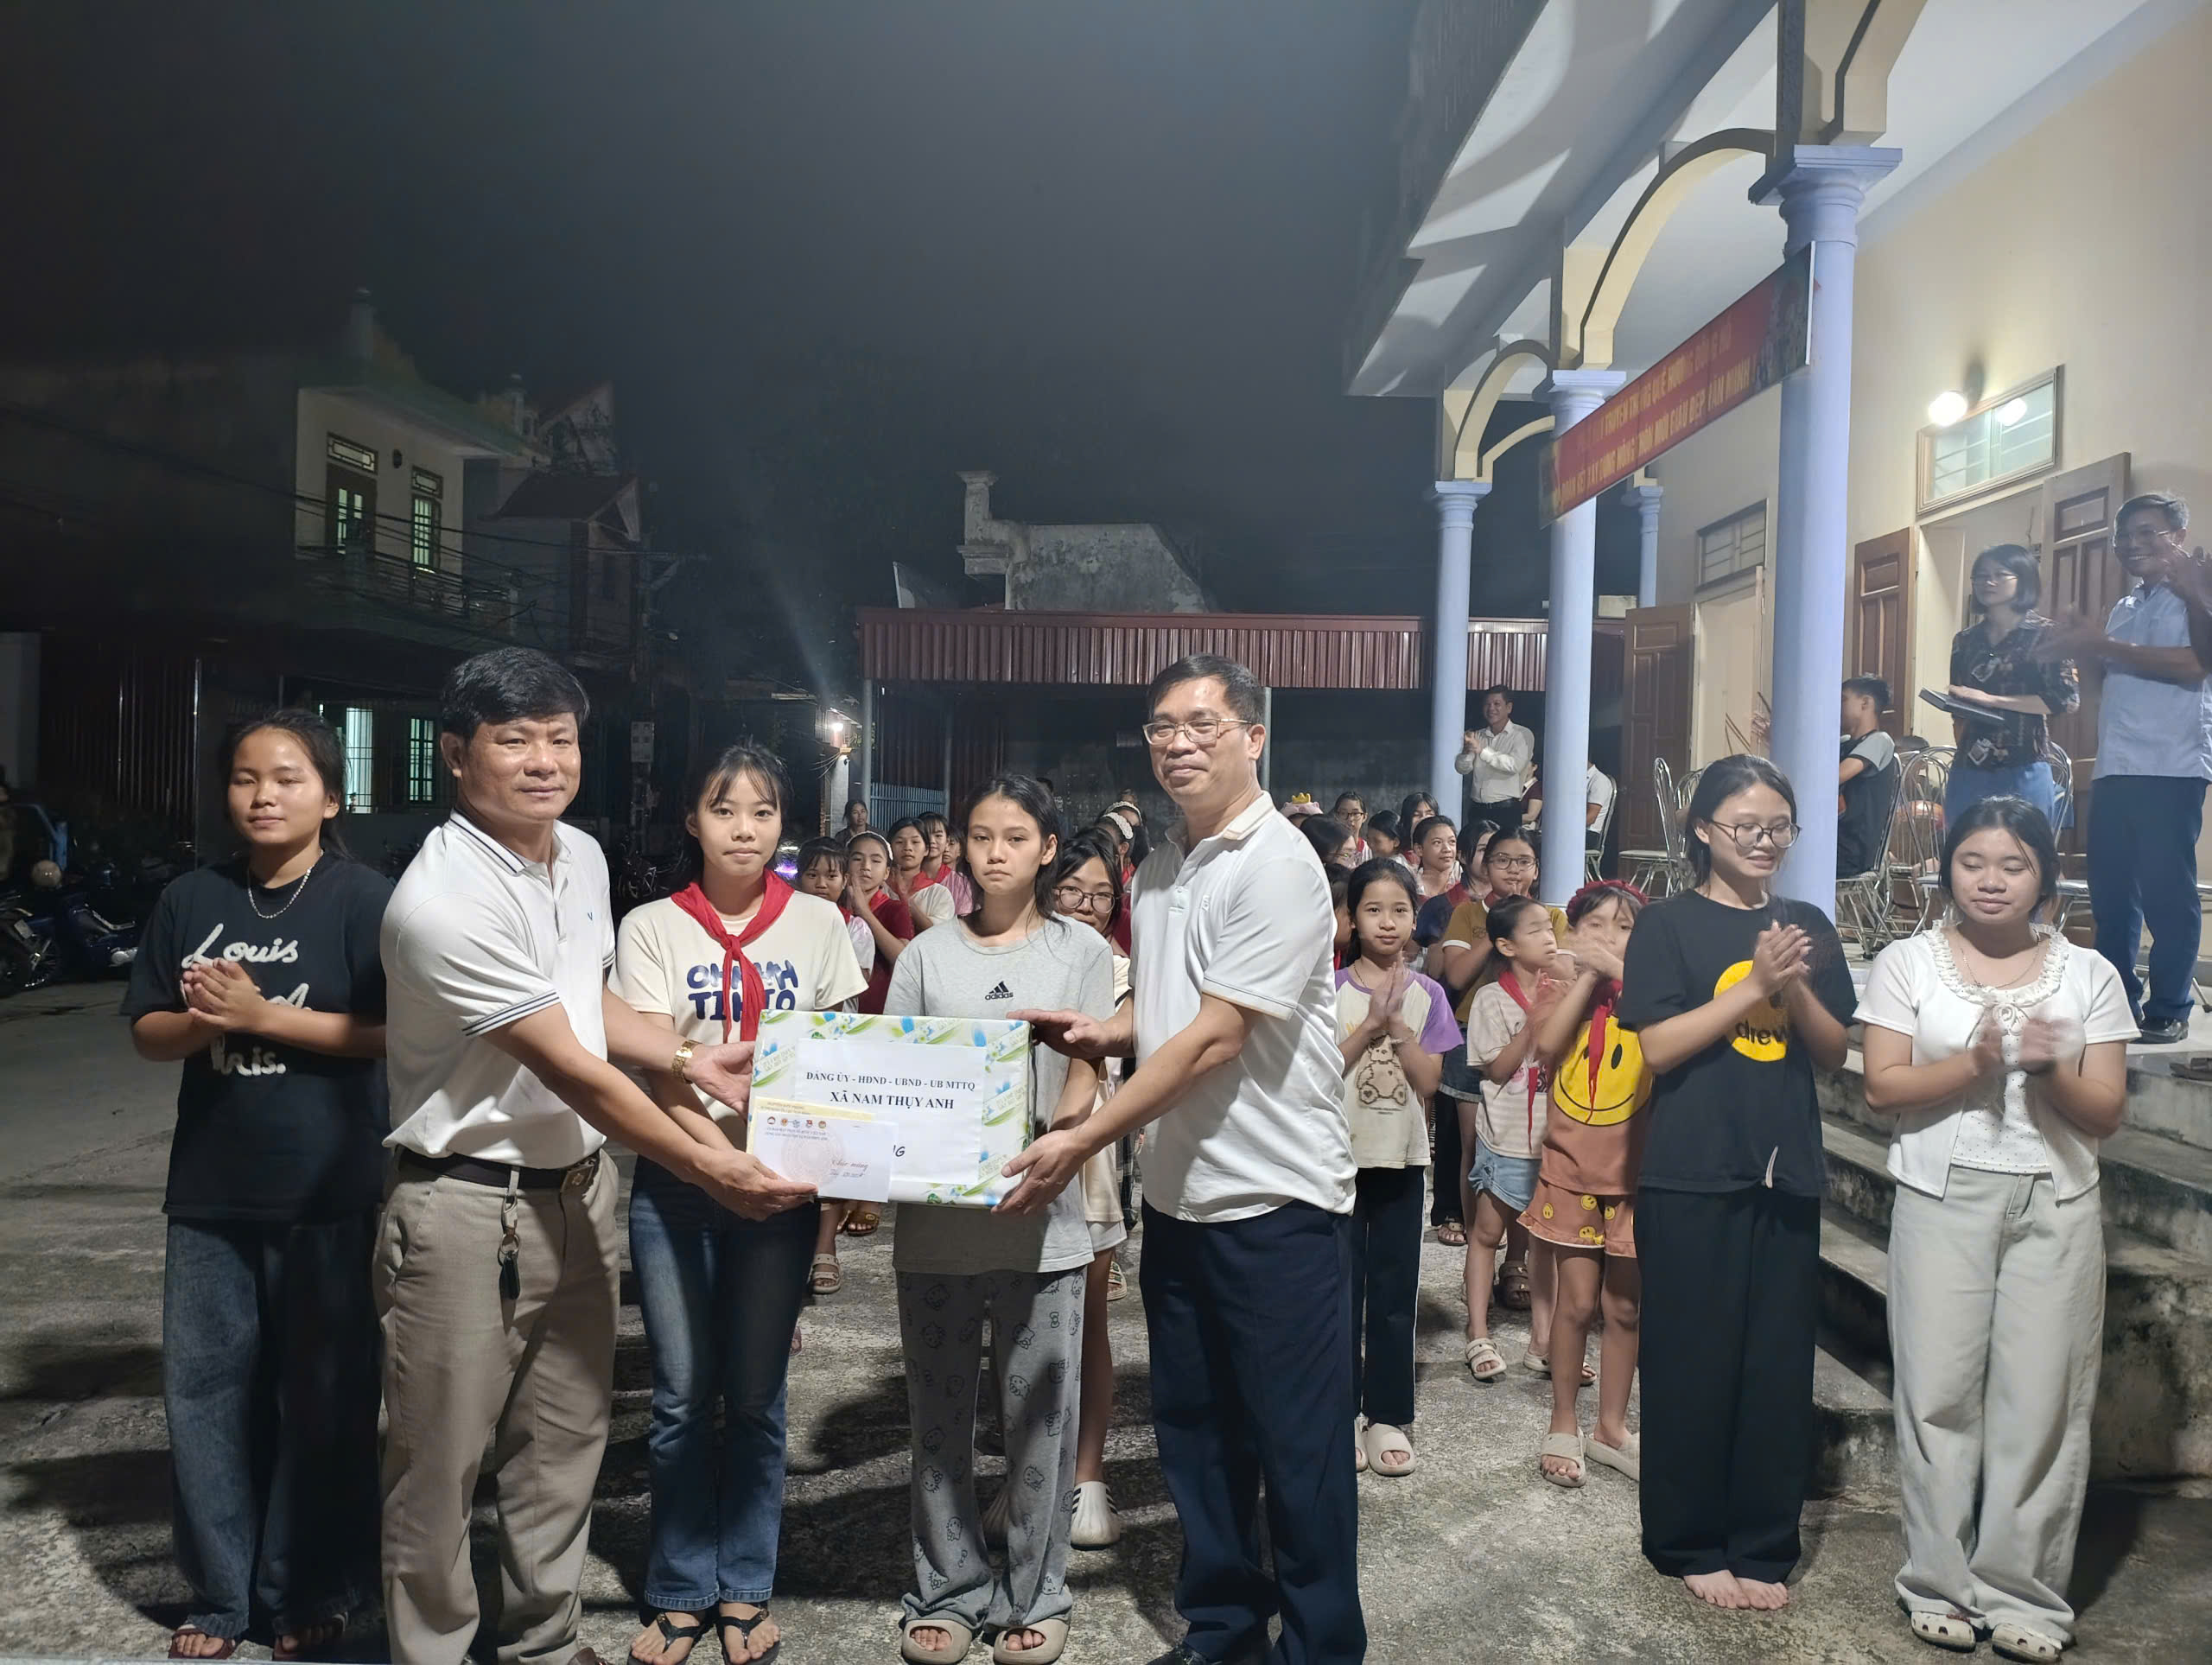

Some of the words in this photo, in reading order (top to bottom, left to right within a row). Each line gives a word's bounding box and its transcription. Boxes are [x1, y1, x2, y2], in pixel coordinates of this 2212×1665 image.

[985, 992, 1014, 1001] adidas
[858, 1075, 887, 1085] HĐND
[895, 1077, 922, 1088] UBND
[930, 1079, 944, 1089] UB
[946, 1081, 976, 1091] MTTQ
[830, 1090, 849, 1103] XÃ
[851, 1093, 882, 1105] NAM
[887, 1095, 924, 1110] THỤY
[925, 1097, 954, 1109] ANH
